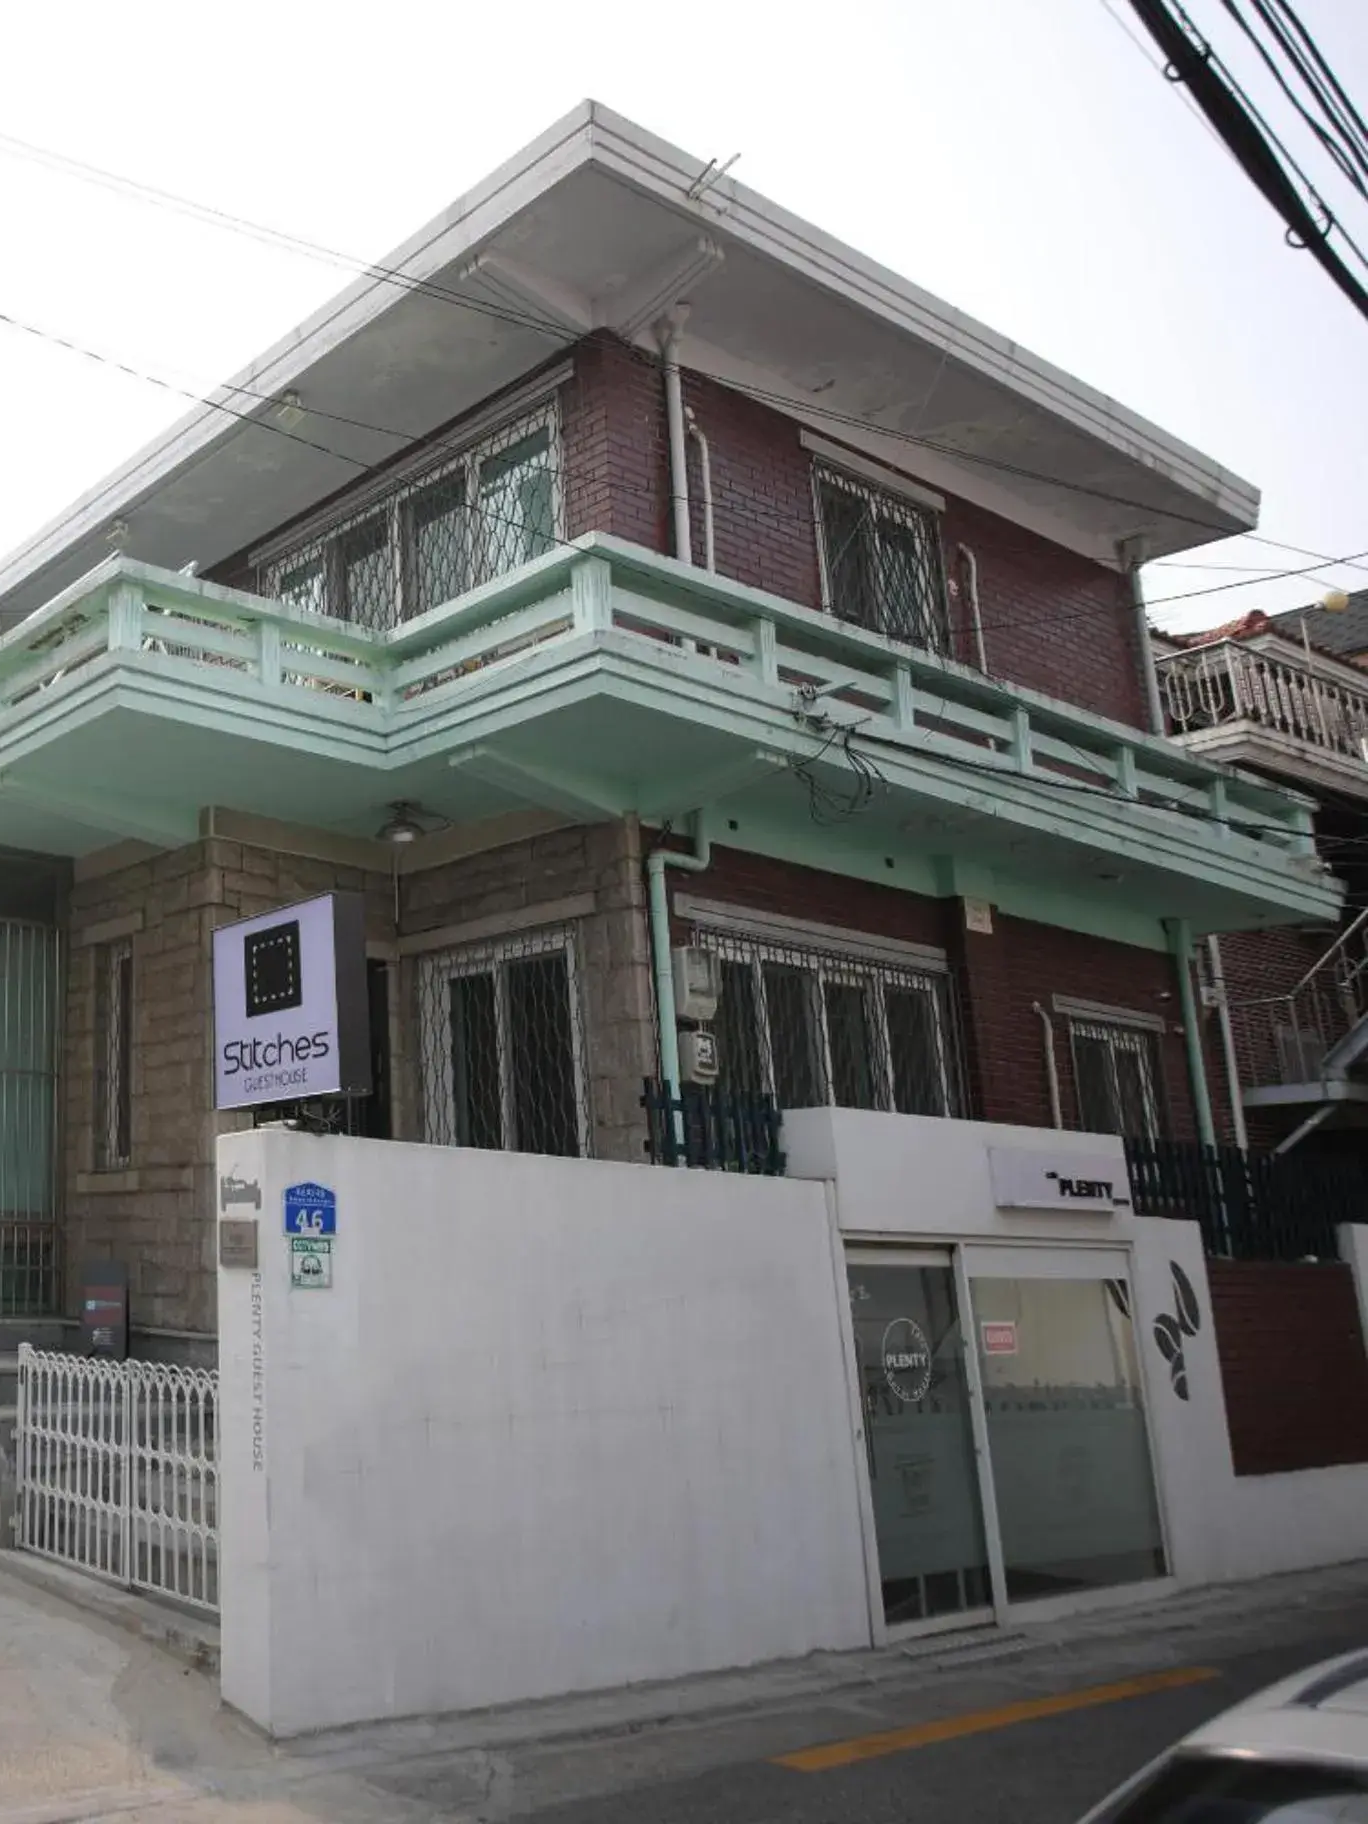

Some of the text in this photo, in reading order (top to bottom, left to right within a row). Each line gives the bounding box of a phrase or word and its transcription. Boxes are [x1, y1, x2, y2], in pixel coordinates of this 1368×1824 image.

[224, 1031, 330, 1076] Stitches
[1058, 1178, 1113, 1199] PLENTY
[295, 1208, 324, 1230] 46
[251, 1272, 264, 1472] PLENTY GUEST HOUSE
[885, 1353, 927, 1369] PLENTY
